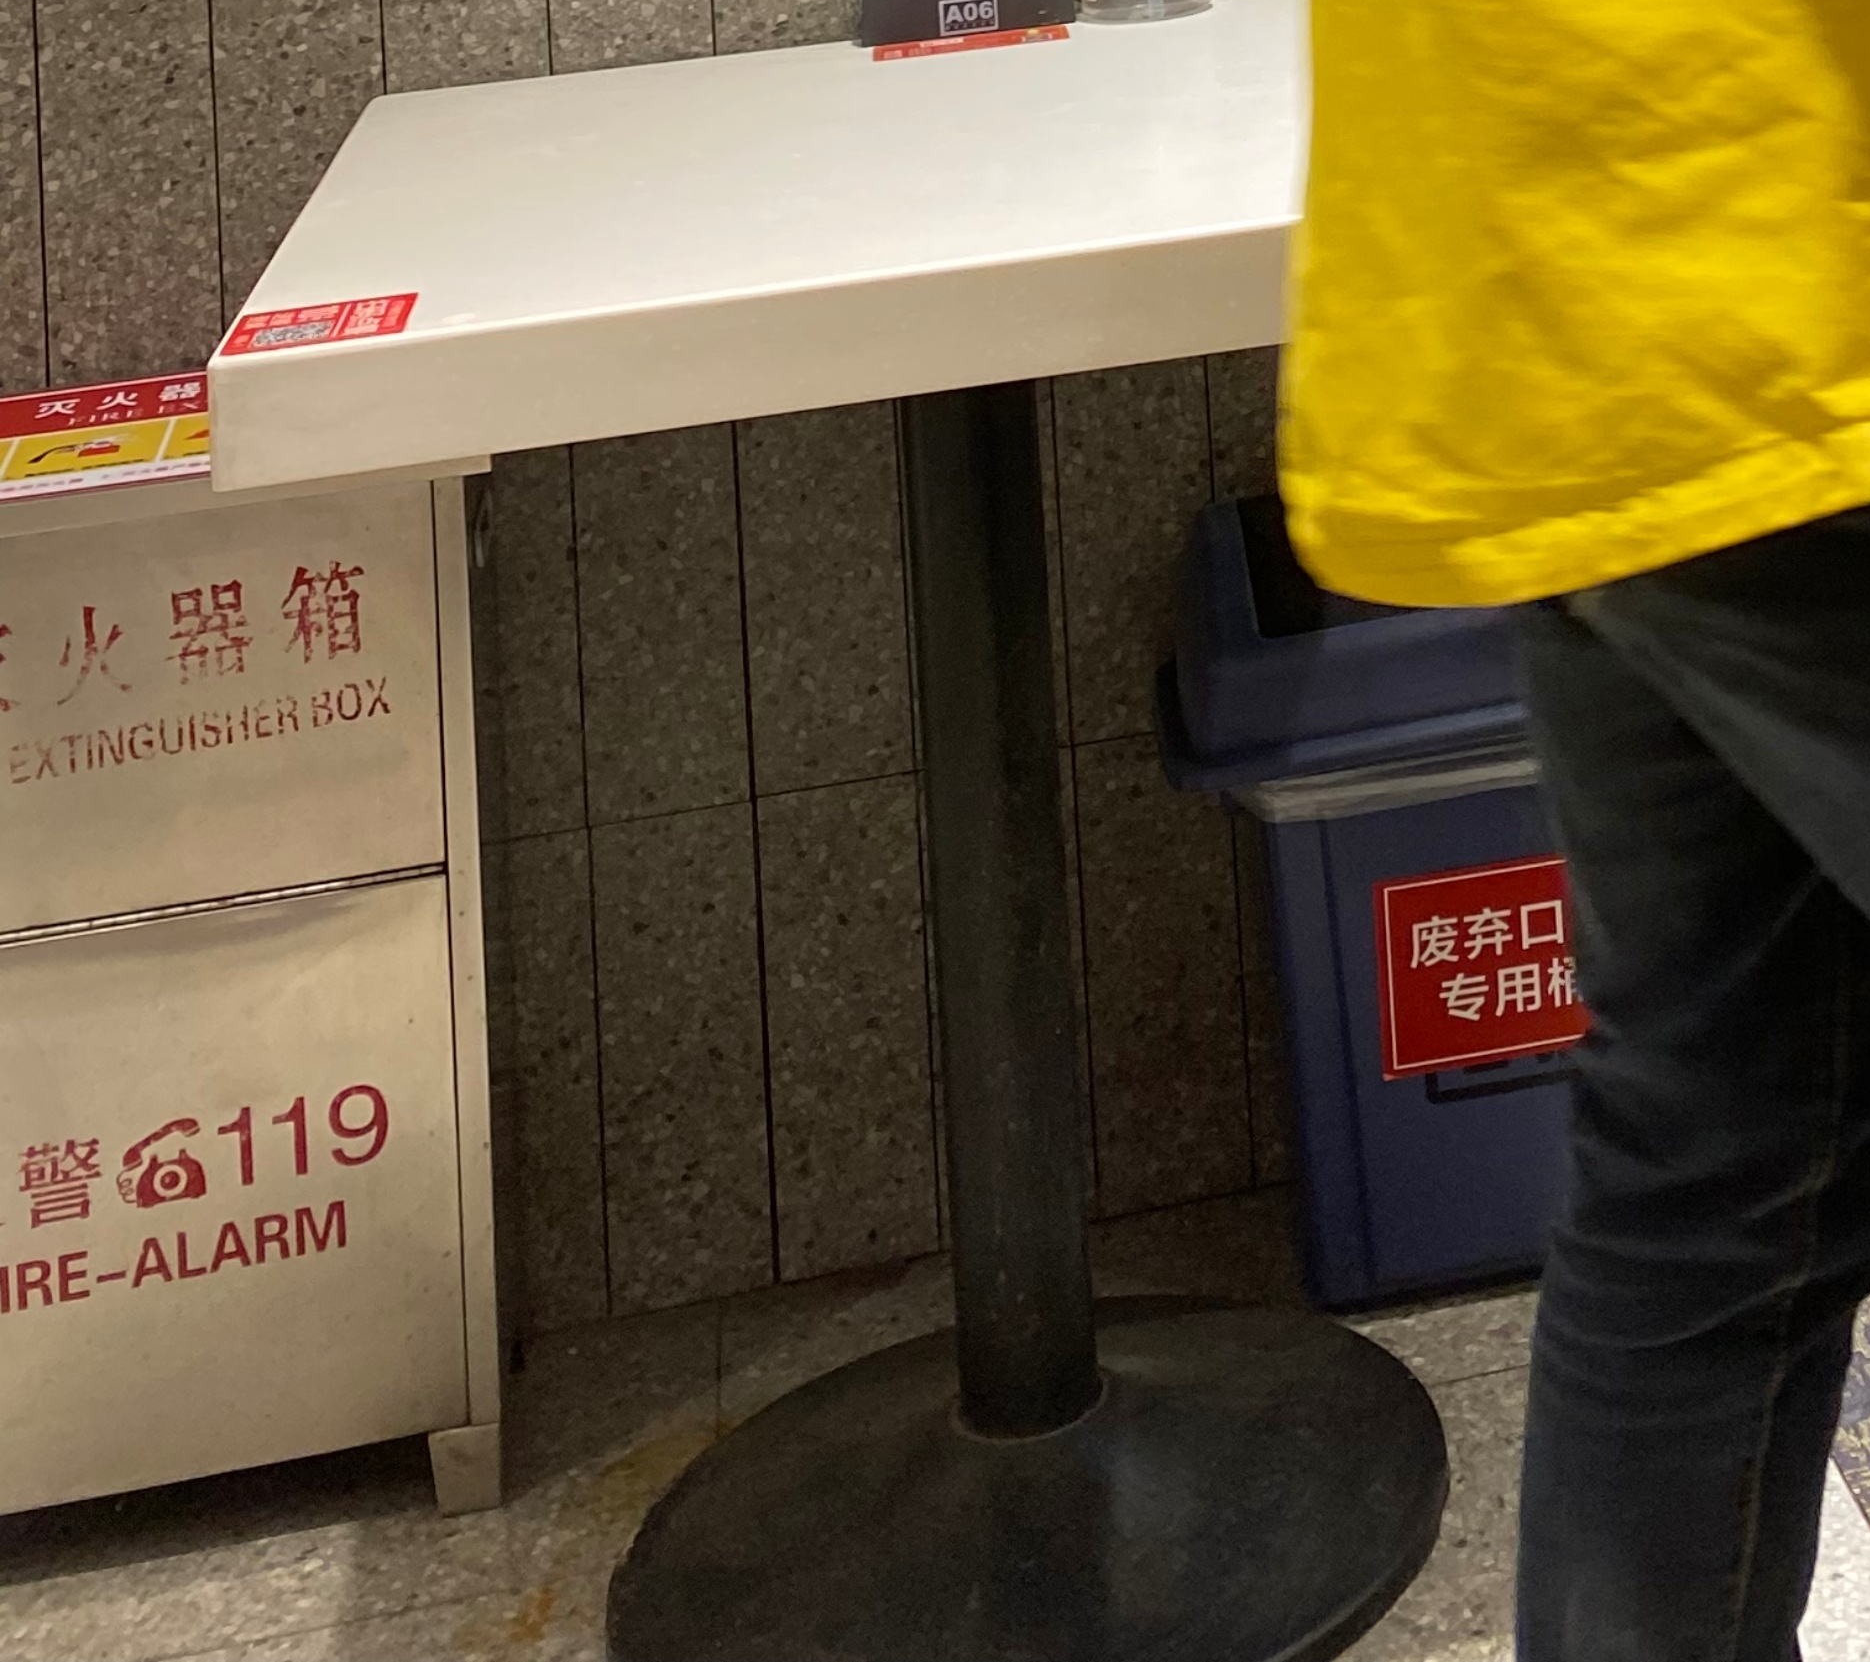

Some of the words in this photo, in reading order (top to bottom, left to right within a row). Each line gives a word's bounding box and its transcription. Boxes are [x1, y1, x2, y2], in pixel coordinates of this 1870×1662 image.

[945, 1, 994, 24] A06
[0, 561, 365, 712] 火器箱
[310, 677, 391, 729] BOX
[1409, 899, 1564, 970] 废弃口
[217, 1084, 390, 1187] 119
